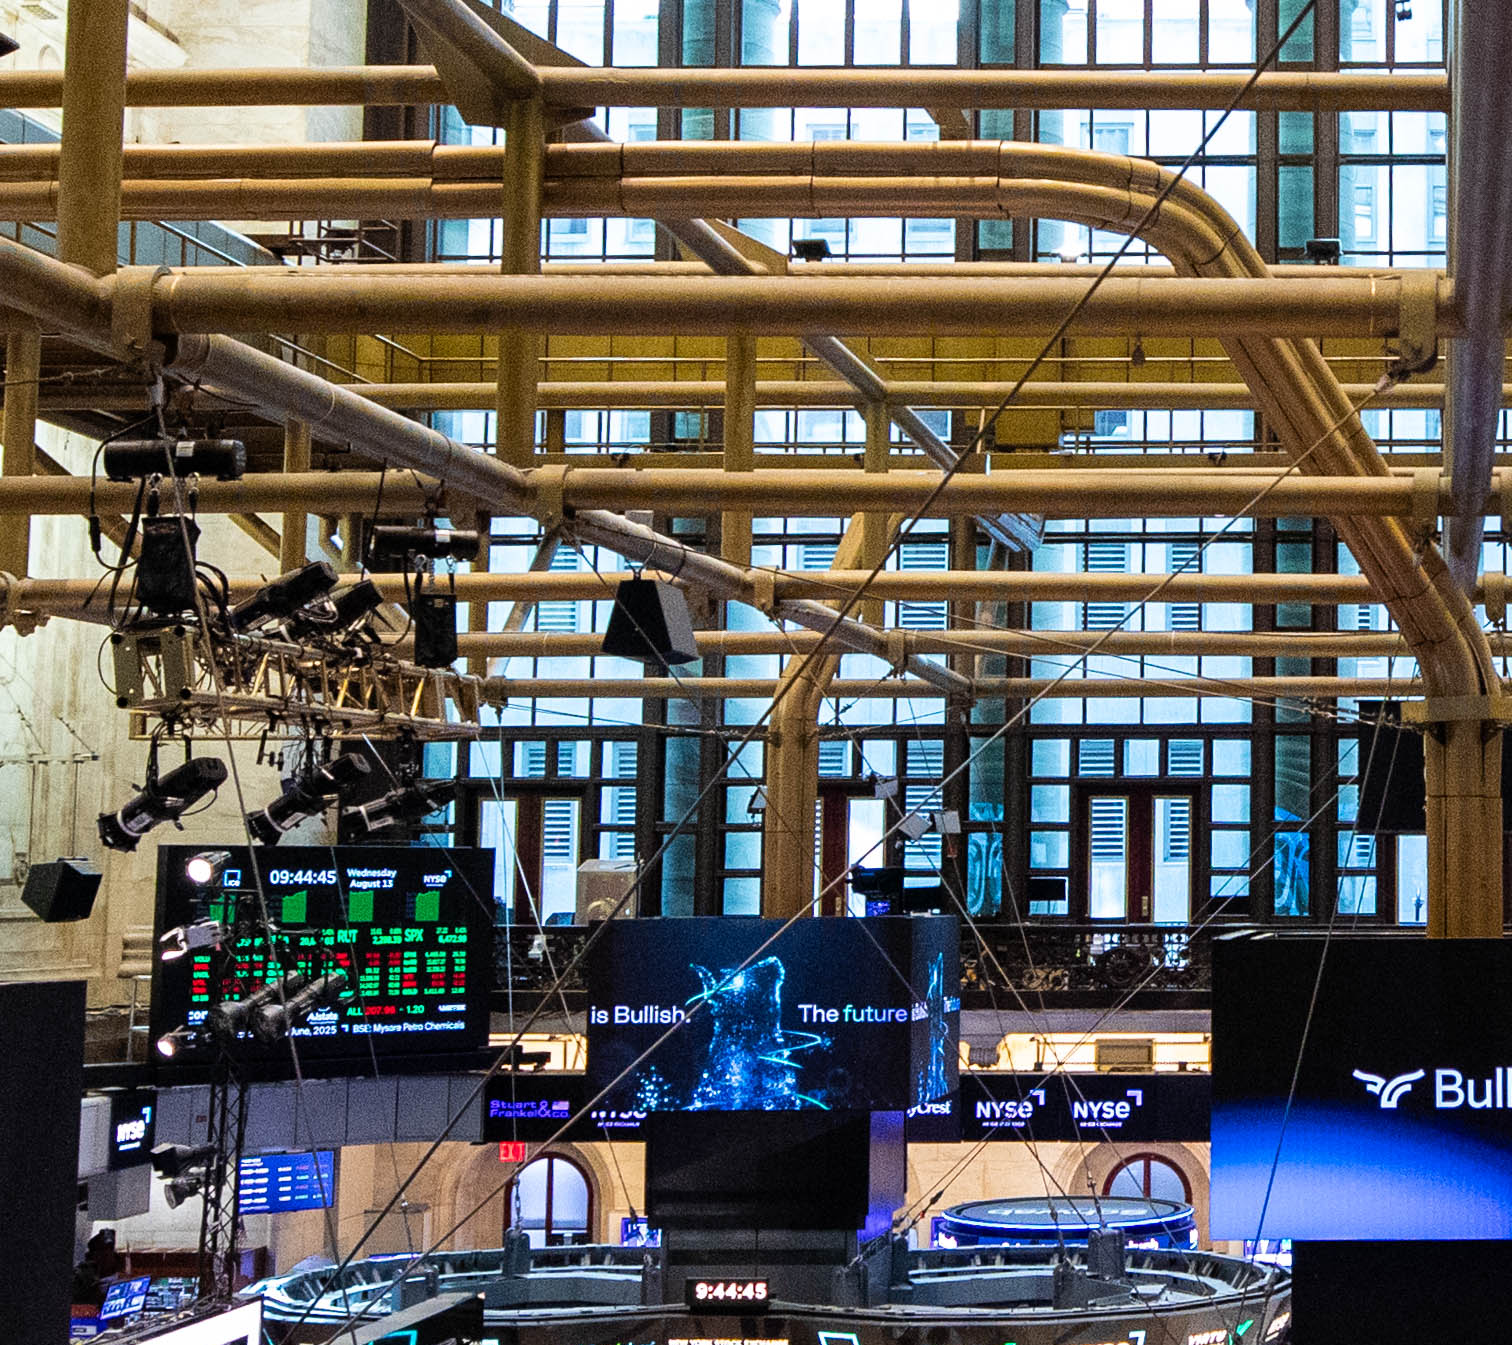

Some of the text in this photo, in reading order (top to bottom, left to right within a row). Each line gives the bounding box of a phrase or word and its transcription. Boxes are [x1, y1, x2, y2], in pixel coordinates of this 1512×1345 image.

[269, 869, 336, 885] 09:44:45
[346, 868, 397, 881] Wednesday
[349, 879, 394, 890] August 13
[591, 1005, 692, 1024] is Bullish.
[798, 1004, 839, 1023] The
[842, 1004, 908, 1023] future
[490, 1099, 537, 1110] Stuart
[500, 1143, 525, 1162] EXIT
[695, 1281, 767, 1301] 9:44:45
